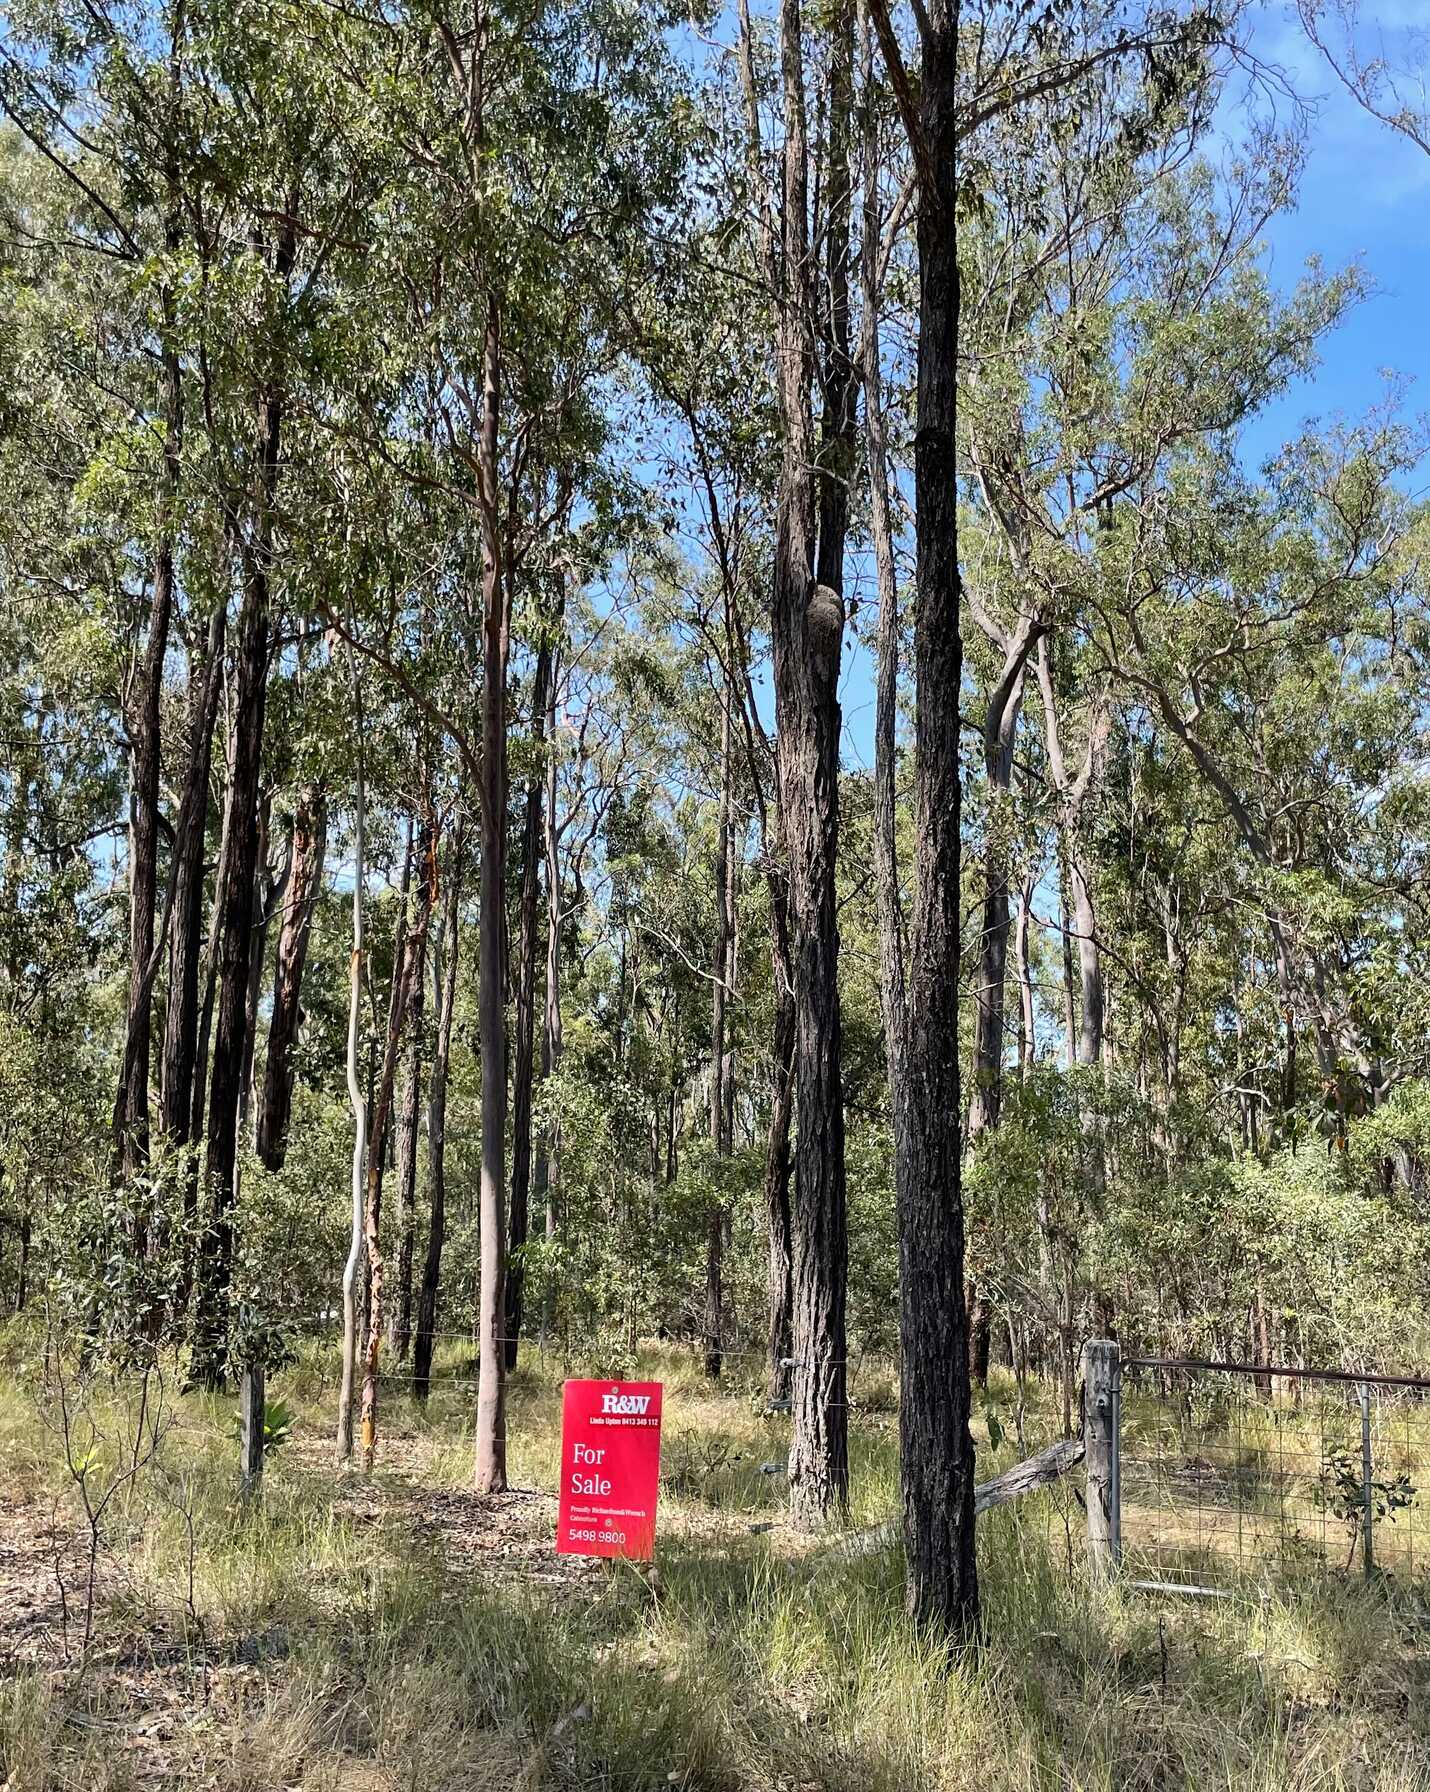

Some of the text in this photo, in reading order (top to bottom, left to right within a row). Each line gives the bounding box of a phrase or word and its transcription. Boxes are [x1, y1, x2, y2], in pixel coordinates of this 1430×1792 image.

[602, 1395, 650, 1414] R&W
[621, 1417, 636, 1426] 0413
[648, 1418, 659, 1426] 112
[573, 1443, 605, 1465] For
[571, 1473, 612, 1496] Sale
[568, 1528, 626, 1544] 5498 9800
